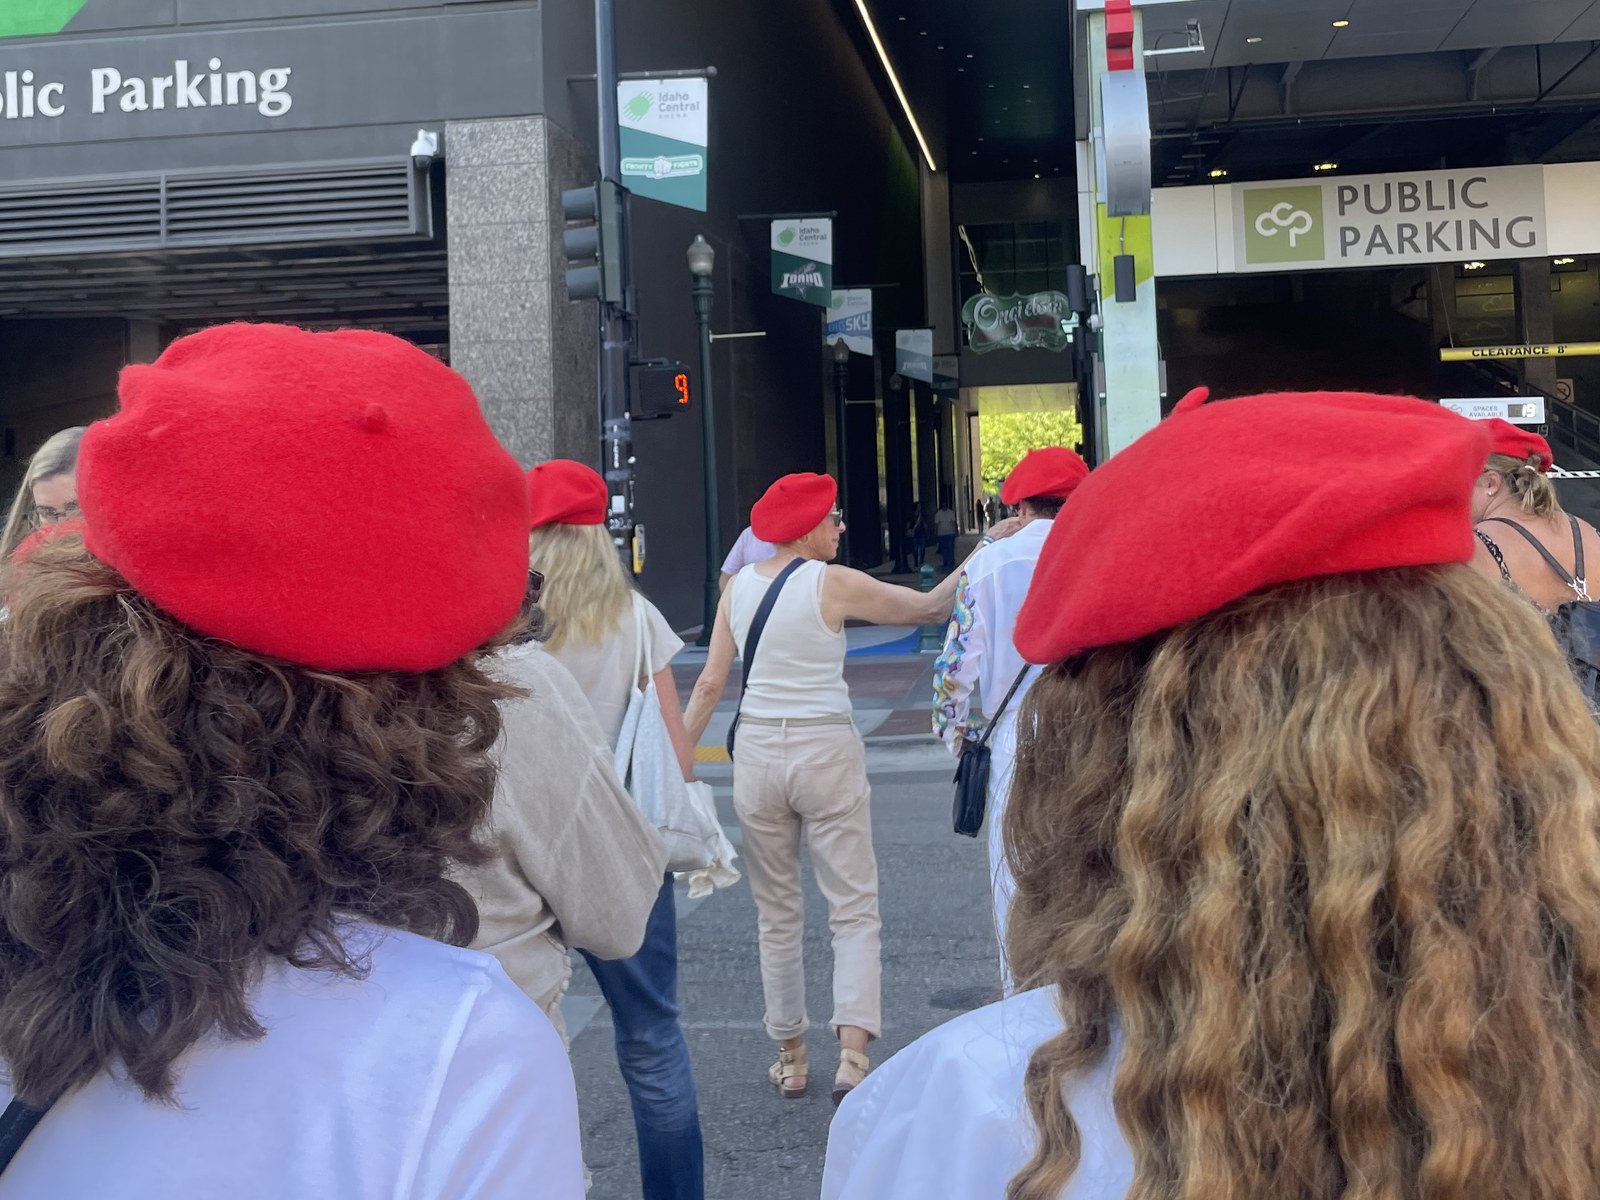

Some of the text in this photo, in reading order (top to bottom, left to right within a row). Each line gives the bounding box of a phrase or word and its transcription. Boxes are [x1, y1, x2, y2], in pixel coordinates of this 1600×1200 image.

[0, 57, 292, 119] lic Parking
[658, 93, 689, 102] Idaho
[658, 101, 700, 113] Central
[1337, 177, 1489, 216] PUBLIC
[799, 233, 827, 241] Central
[1339, 216, 1536, 257] PARKING
[1472, 346, 1549, 357] CLEARANCE
[675, 373, 689, 404] 9
[1522, 403, 1536, 418] 19
